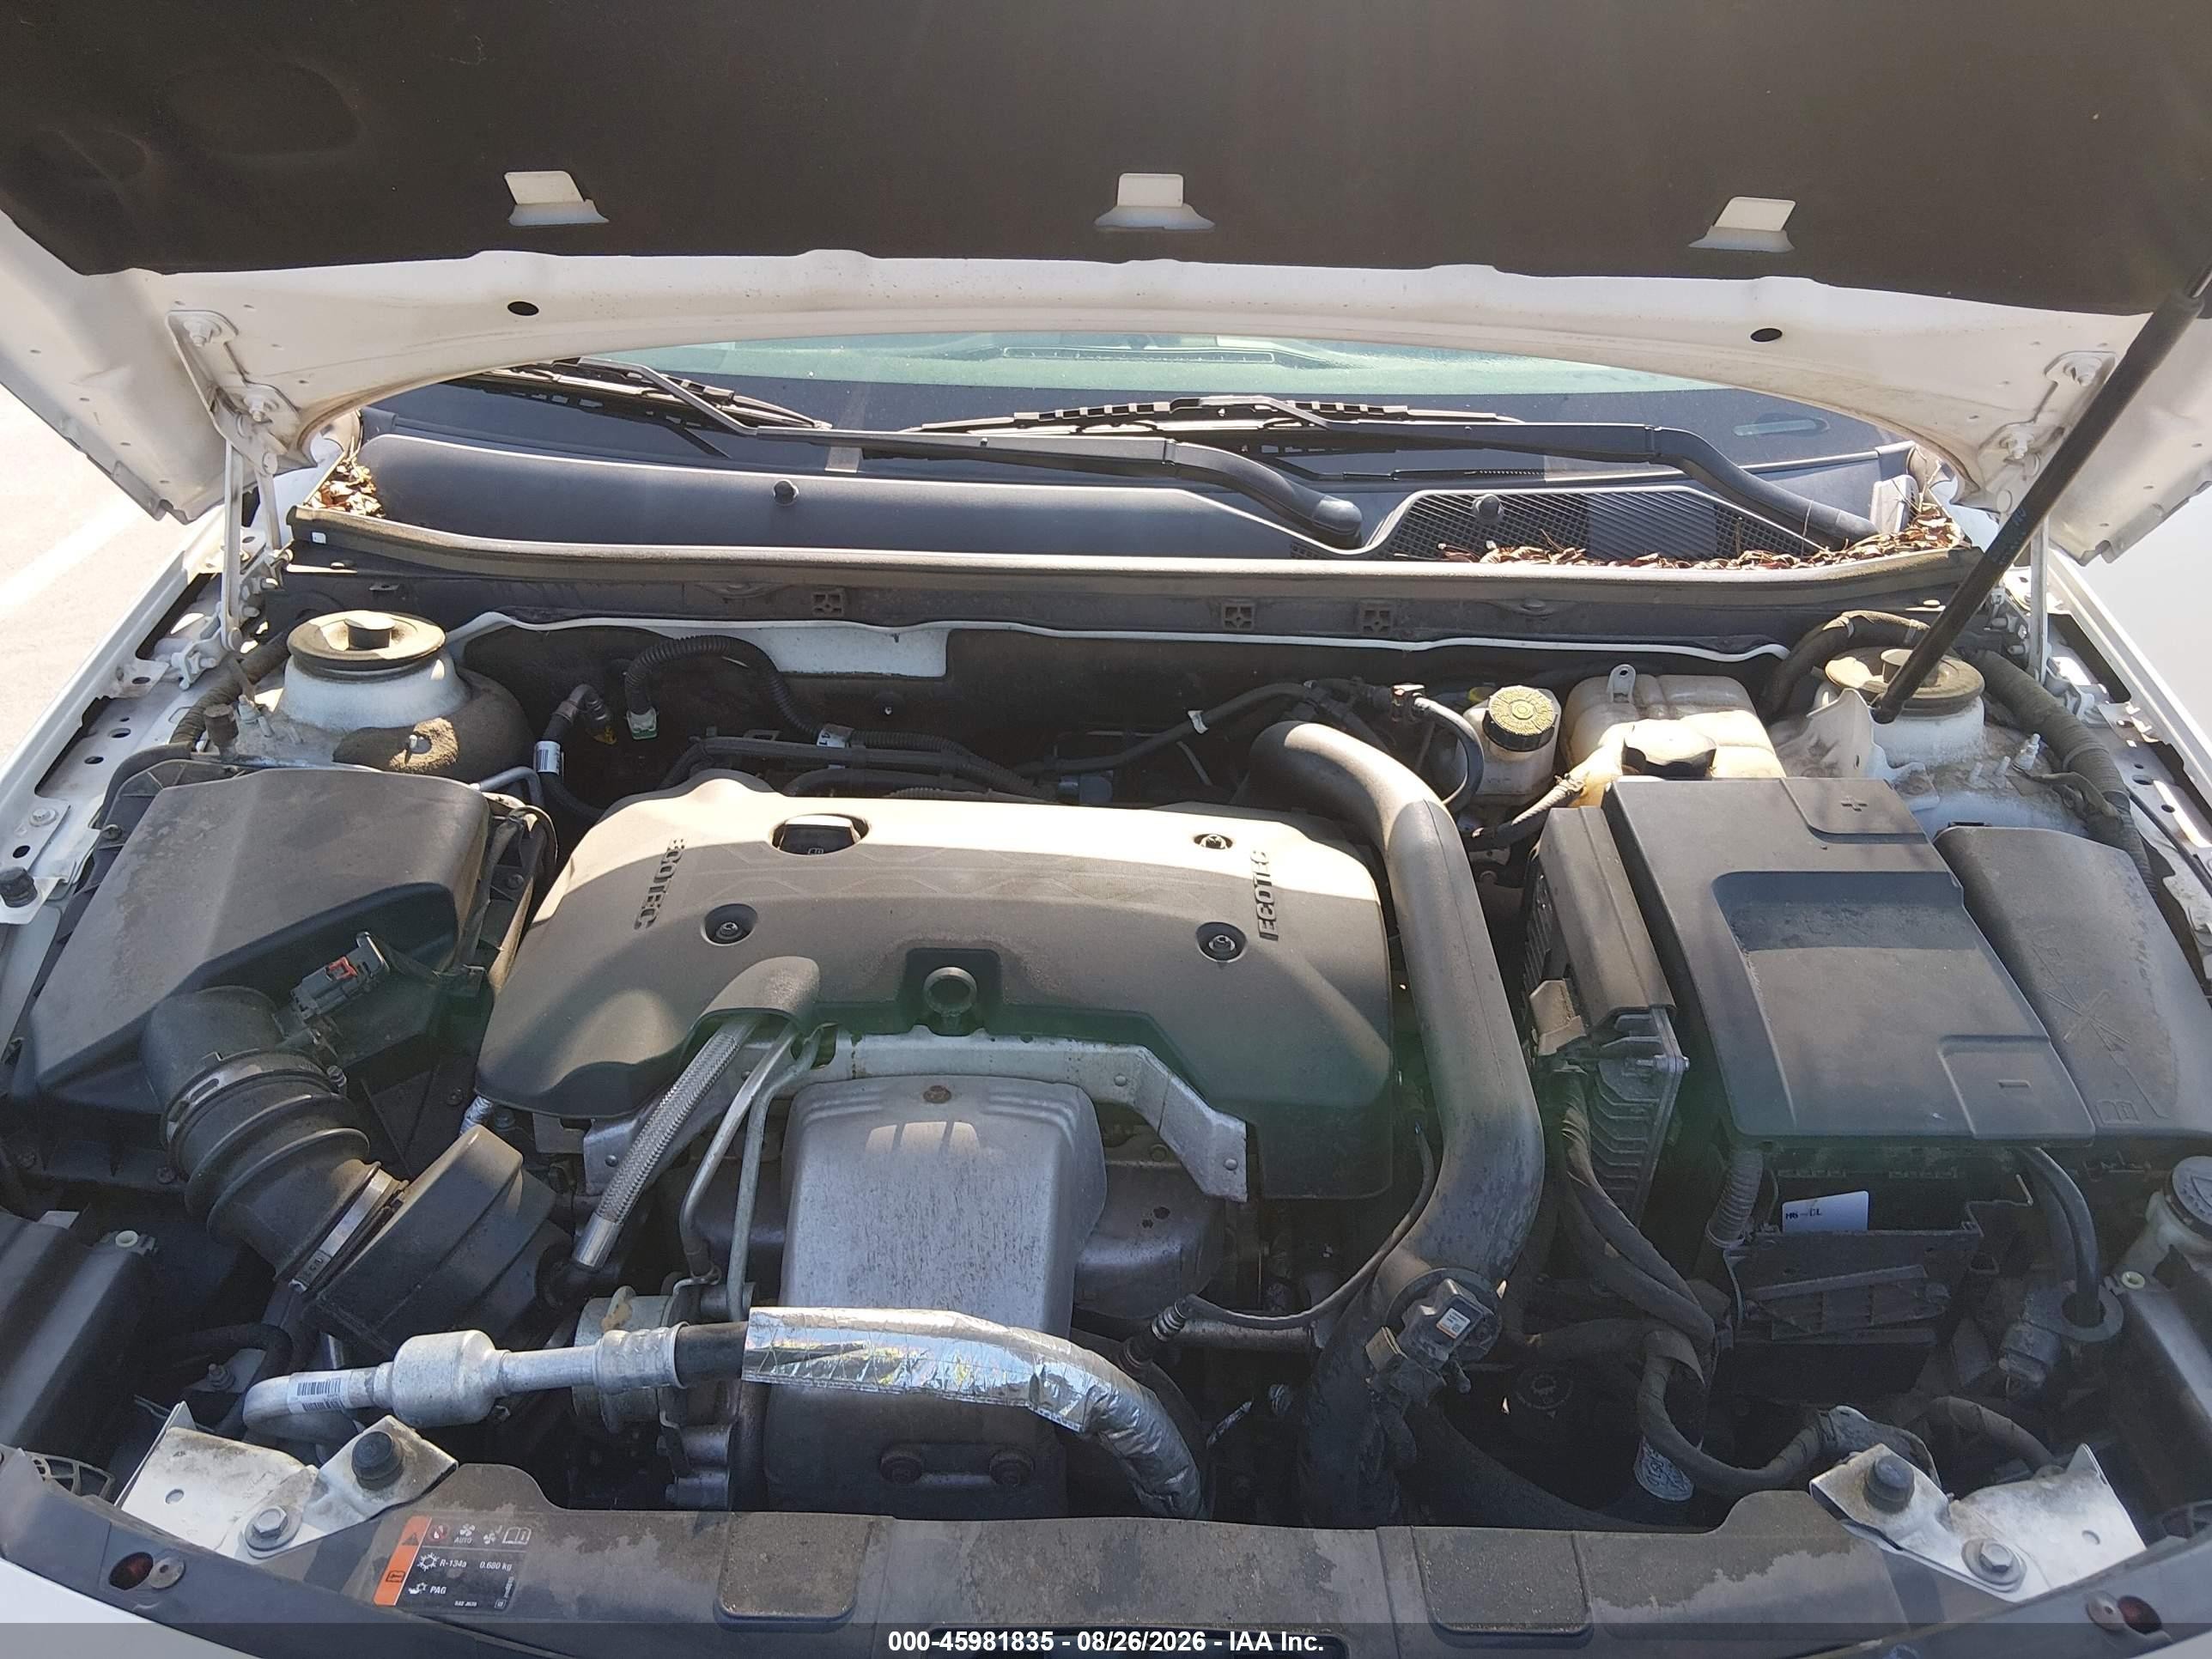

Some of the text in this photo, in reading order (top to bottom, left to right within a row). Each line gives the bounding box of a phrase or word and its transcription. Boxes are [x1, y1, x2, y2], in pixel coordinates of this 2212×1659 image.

[634, 838, 687, 929] ECOTEC
[1250, 849, 1279, 941] ECOTEC
[429, 1585, 447, 1595] PAG
[440, 1559, 467, 1568] R-134a
[501, 1562, 513, 1571] kg
